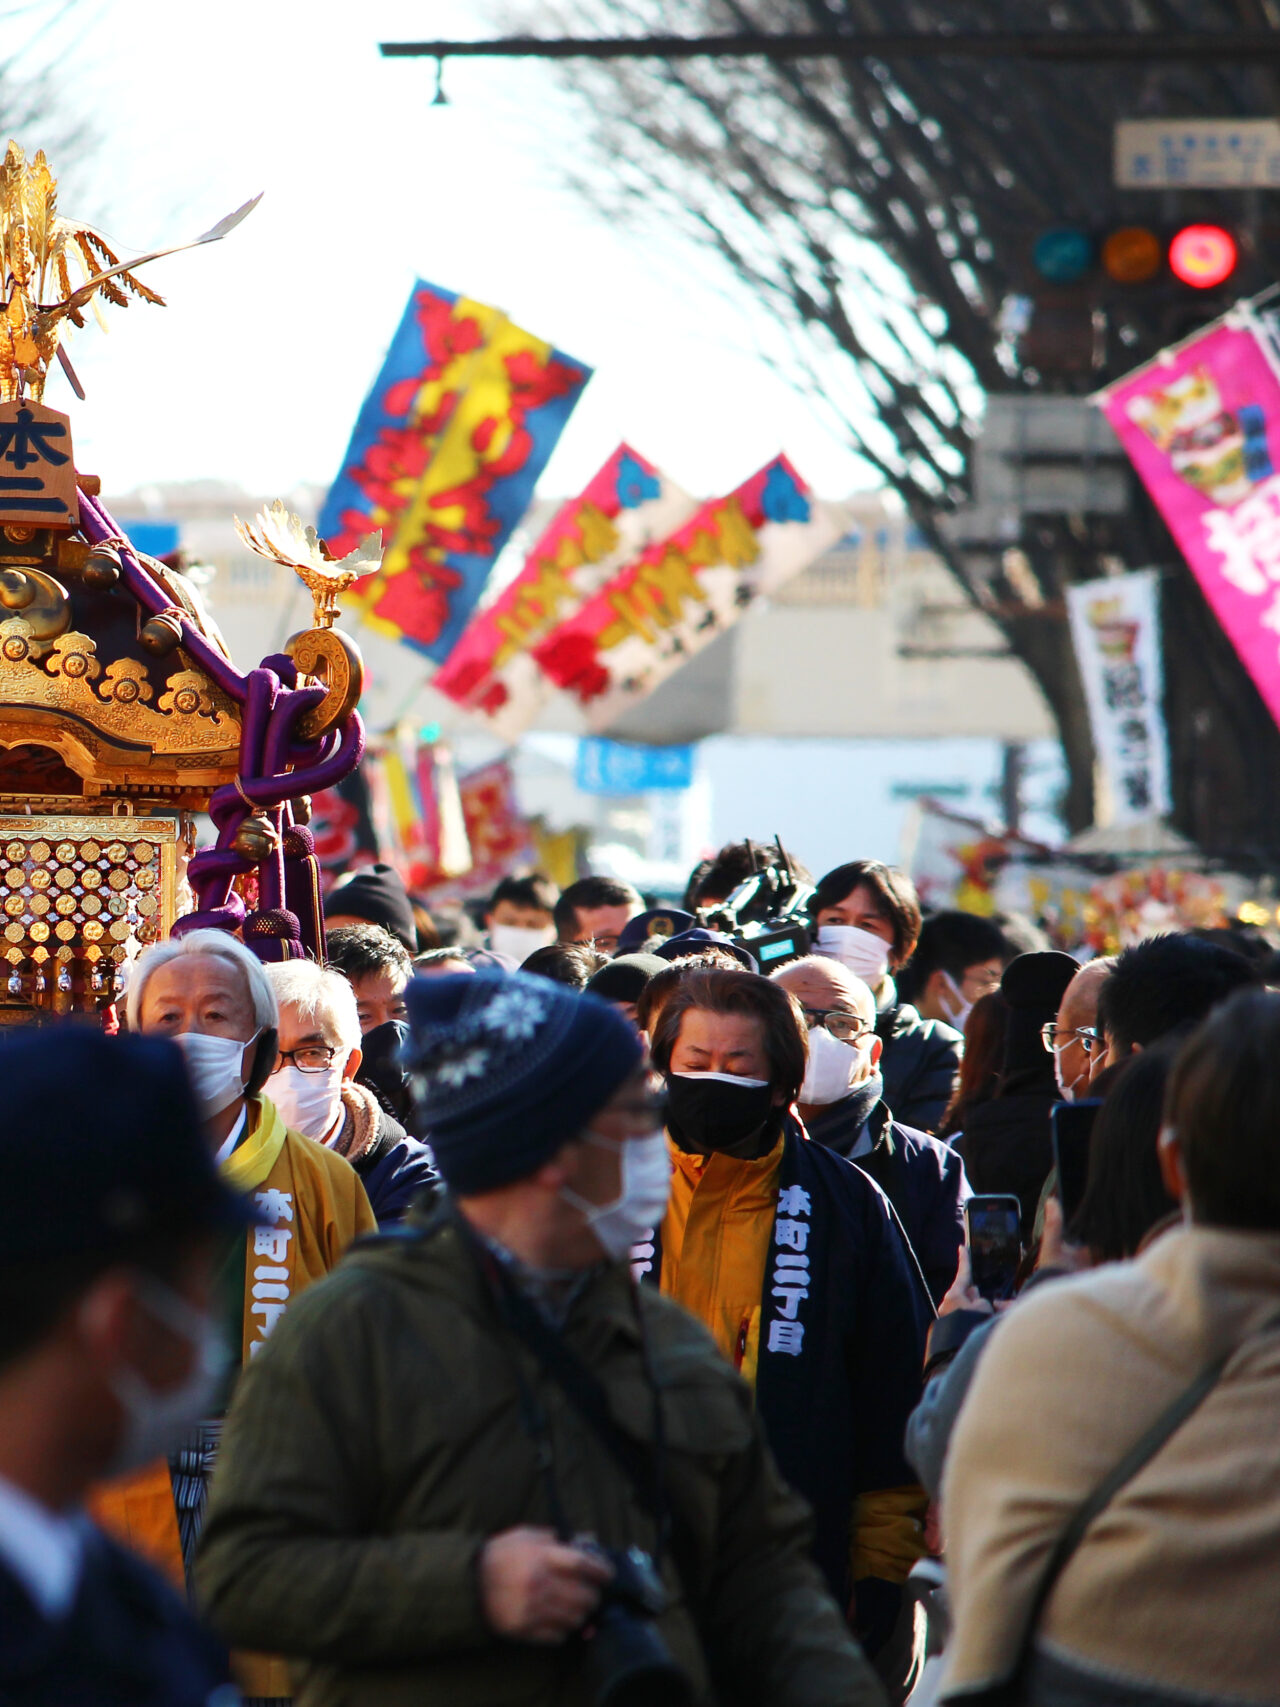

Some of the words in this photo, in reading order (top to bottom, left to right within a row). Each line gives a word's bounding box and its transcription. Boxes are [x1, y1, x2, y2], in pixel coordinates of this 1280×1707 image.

[250, 1188, 294, 1360] 本町二丁
[767, 1185, 812, 1357] 本町二丁目
